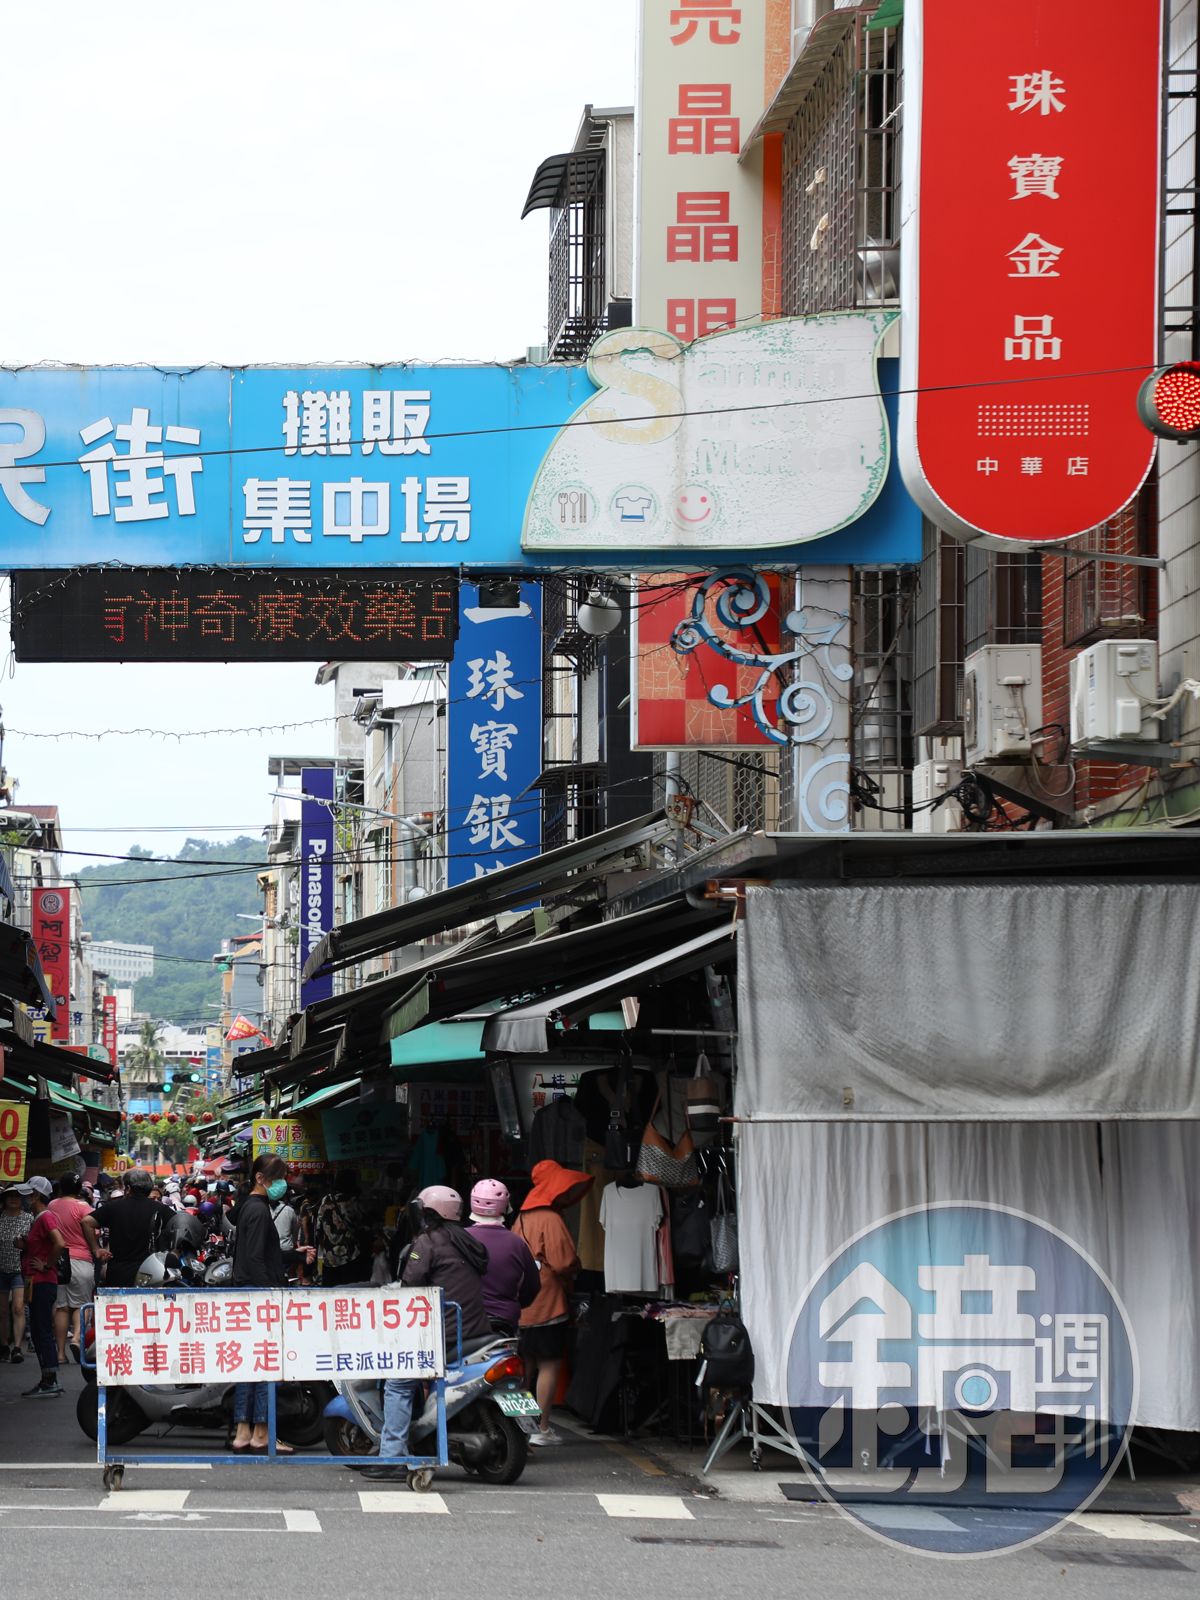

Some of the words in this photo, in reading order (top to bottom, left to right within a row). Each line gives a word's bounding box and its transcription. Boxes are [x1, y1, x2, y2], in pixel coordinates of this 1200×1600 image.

[1003, 69, 1067, 361] 珠寶金品
[281, 389, 433, 457] 攤販
[976, 456, 1090, 477] 中華店
[242, 476, 472, 543] 集中場
[314, 1349, 437, 1373] 三民派出所製
